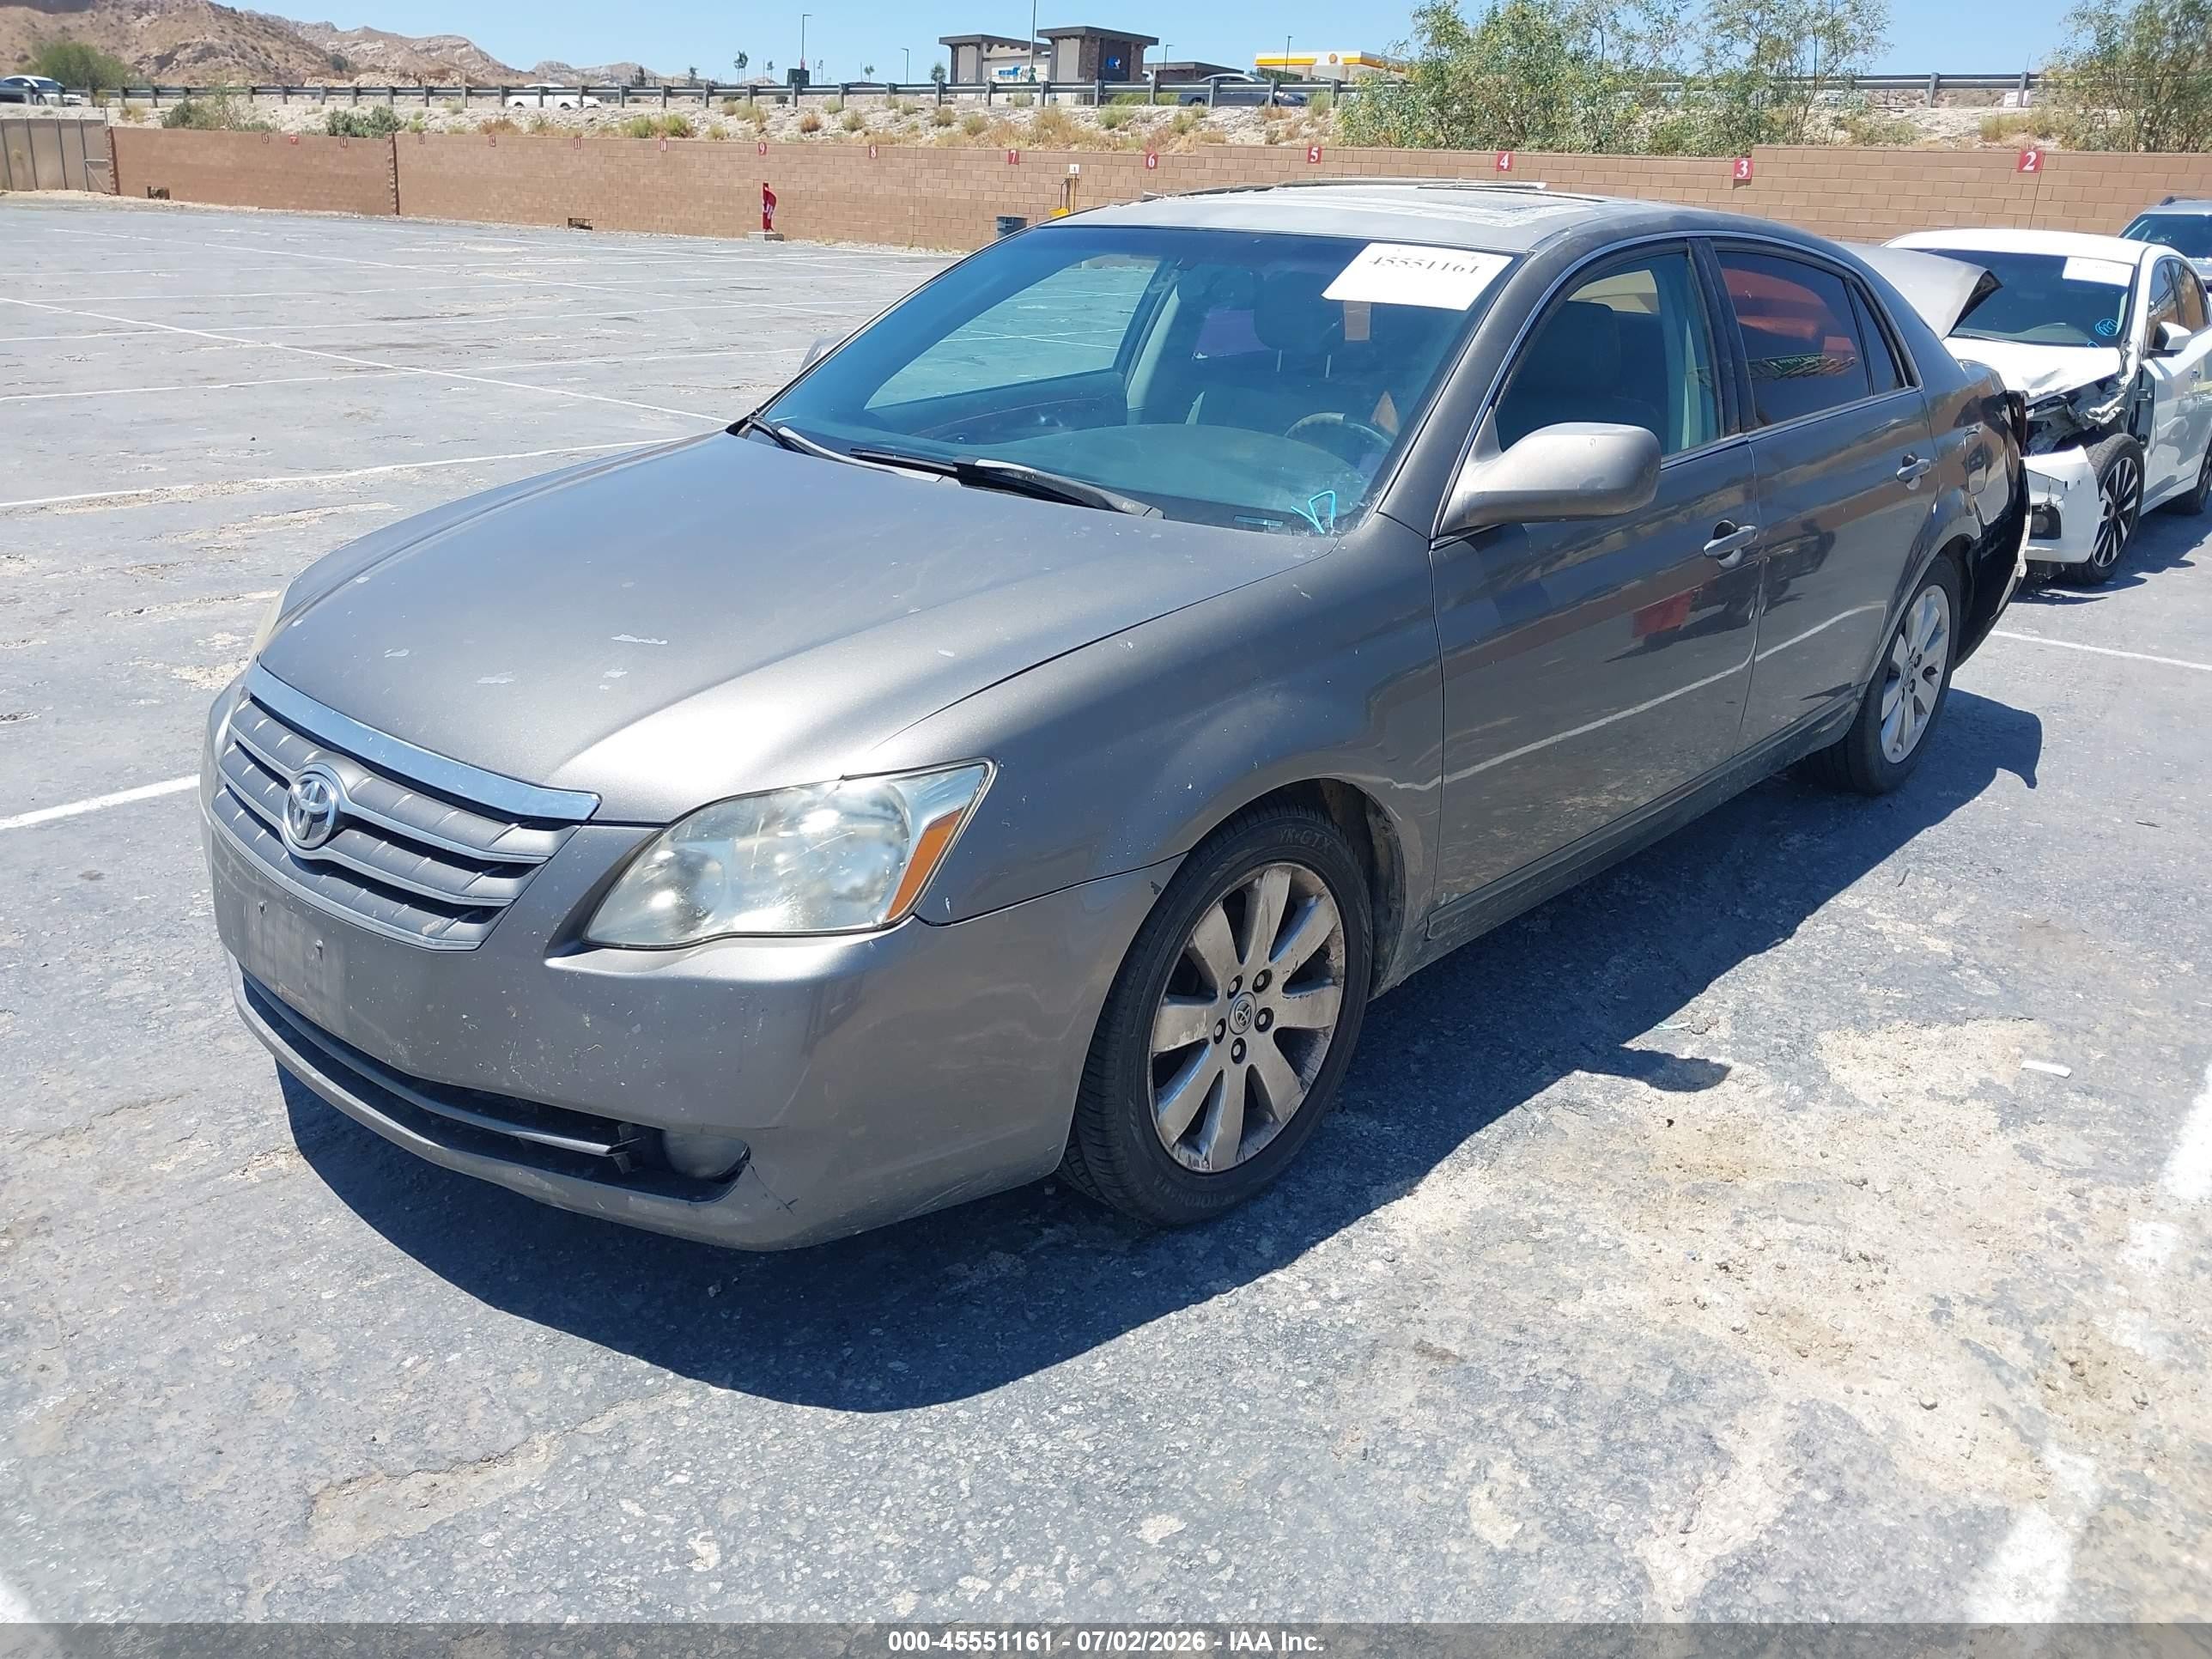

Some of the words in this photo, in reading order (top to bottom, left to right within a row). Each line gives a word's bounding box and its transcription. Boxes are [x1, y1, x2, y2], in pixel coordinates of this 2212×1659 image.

[759, 143, 765, 155] 9
[870, 145, 877, 158] 8
[1010, 149, 1018, 163] 7
[1310, 146, 1319, 162] 5
[1147, 153, 1156, 168] 6
[1499, 153, 1509, 169] 4
[2022, 151, 2037, 171] 2
[1736, 160, 1748, 178] 3
[1369, 256, 1480, 275] 45551161
